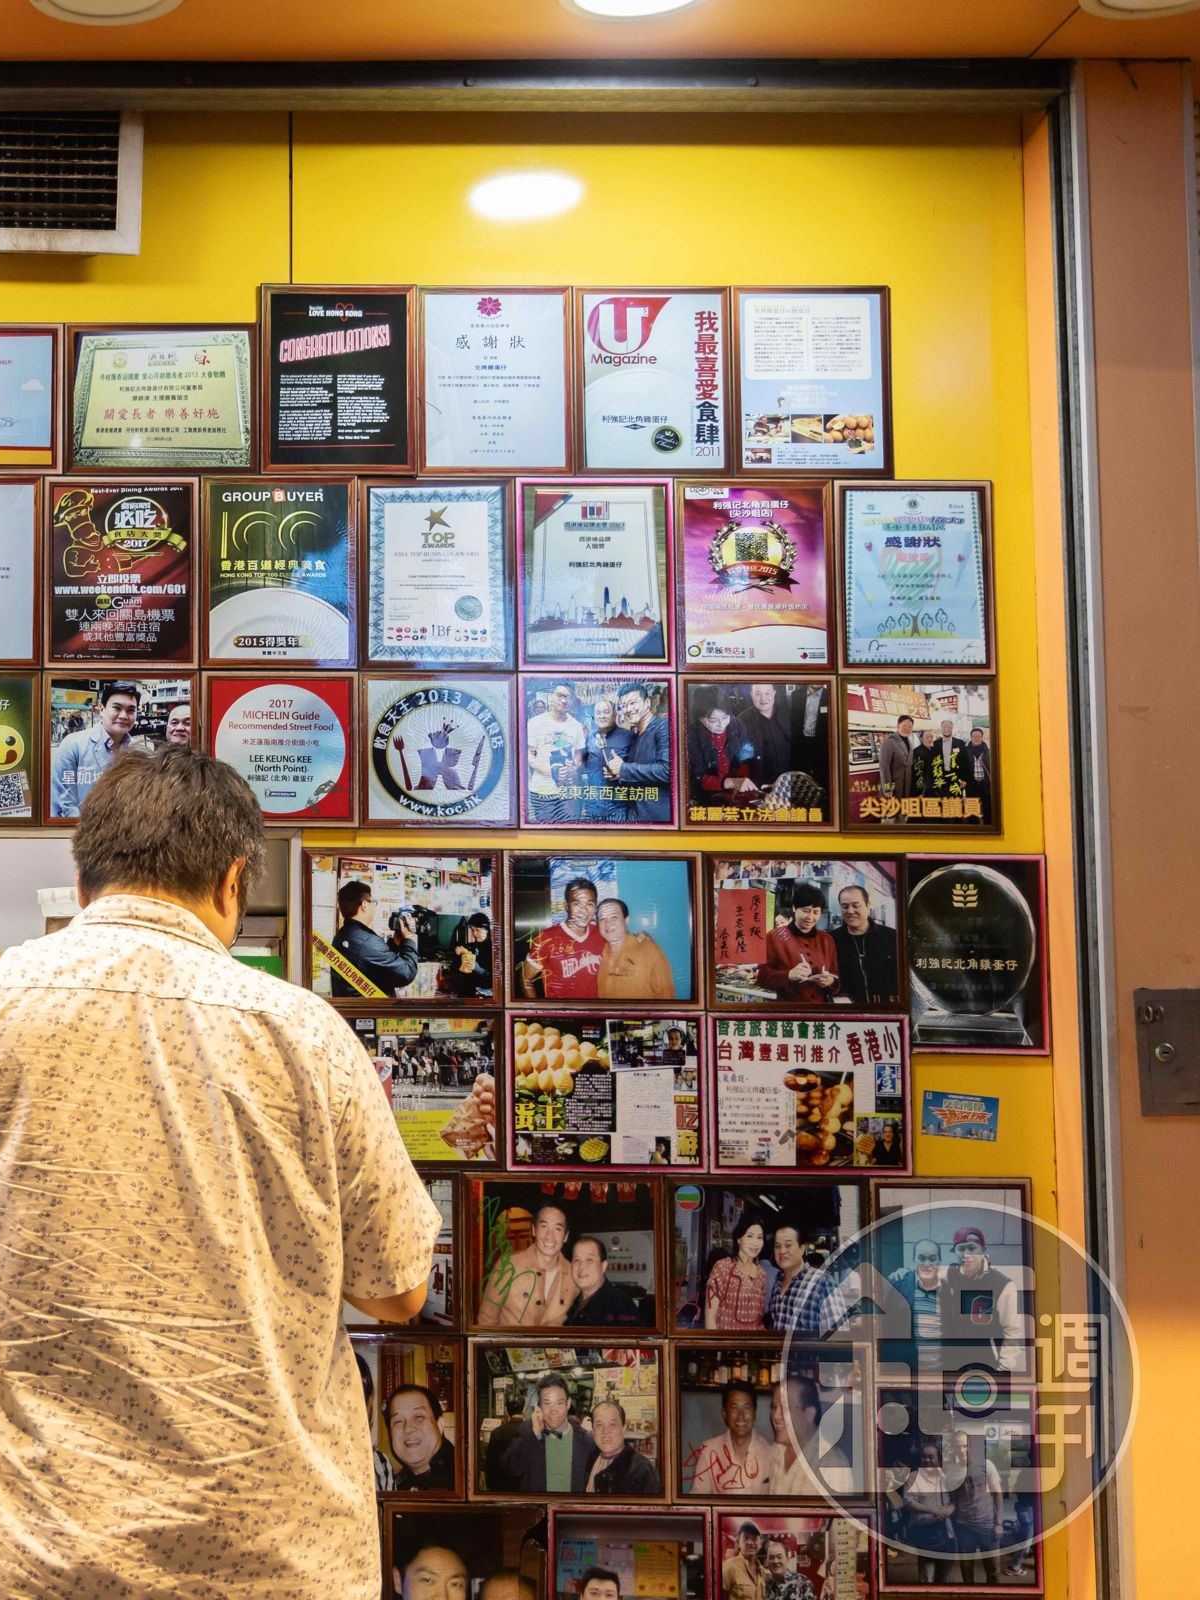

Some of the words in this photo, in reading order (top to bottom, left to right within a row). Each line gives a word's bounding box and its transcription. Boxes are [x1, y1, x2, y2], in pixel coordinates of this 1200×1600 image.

[279, 324, 391, 363] CONGRATULATIONS!
[456, 334, 526, 350] 感謝狀
[591, 353, 658, 367] Magazine
[694, 310, 720, 446] 我最喜愛食肆
[695, 446, 721, 457] 2011
[121, 486, 142, 494] Dining
[222, 491, 271, 503] GROUP
[123, 539, 151, 548] 2017
[421, 532, 455, 544] TOP
[884, 536, 942, 548] 感謝狀
[97, 573, 141, 584] 立即投票
[54, 584, 187, 595] www.weekendhk.com/601
[65, 608, 175, 622] 雙人來回關島機票
[79, 621, 161, 632] 連兩晚酒店住宿
[269, 699, 293, 709] 2017
[242, 710, 290, 721] MICHELIN
[291, 711, 320, 721] Guide
[373, 697, 414, 750] 飲食天王
[417, 689, 462, 705] 2013
[228, 721, 287, 731] Recommended
[289, 722, 311, 731] Street
[313, 722, 334, 731] Food
[249, 754, 264, 764] LEE
[265, 754, 295, 764] KEUNG
[296, 754, 312, 764] KEE
[254, 763, 281, 773] (North
[283, 763, 307, 773] Point)
[399, 793, 482, 817] www.koc.hk
[860, 796, 984, 819] 尖沙咀區議員
[915, 957, 1018, 971] 利強記北角雞蛋仔
[717, 1020, 841, 1040] 香港旅遊協會推介
[717, 1039, 841, 1064] 台灣壹週刊推介
[846, 1026, 900, 1066] 香港小
